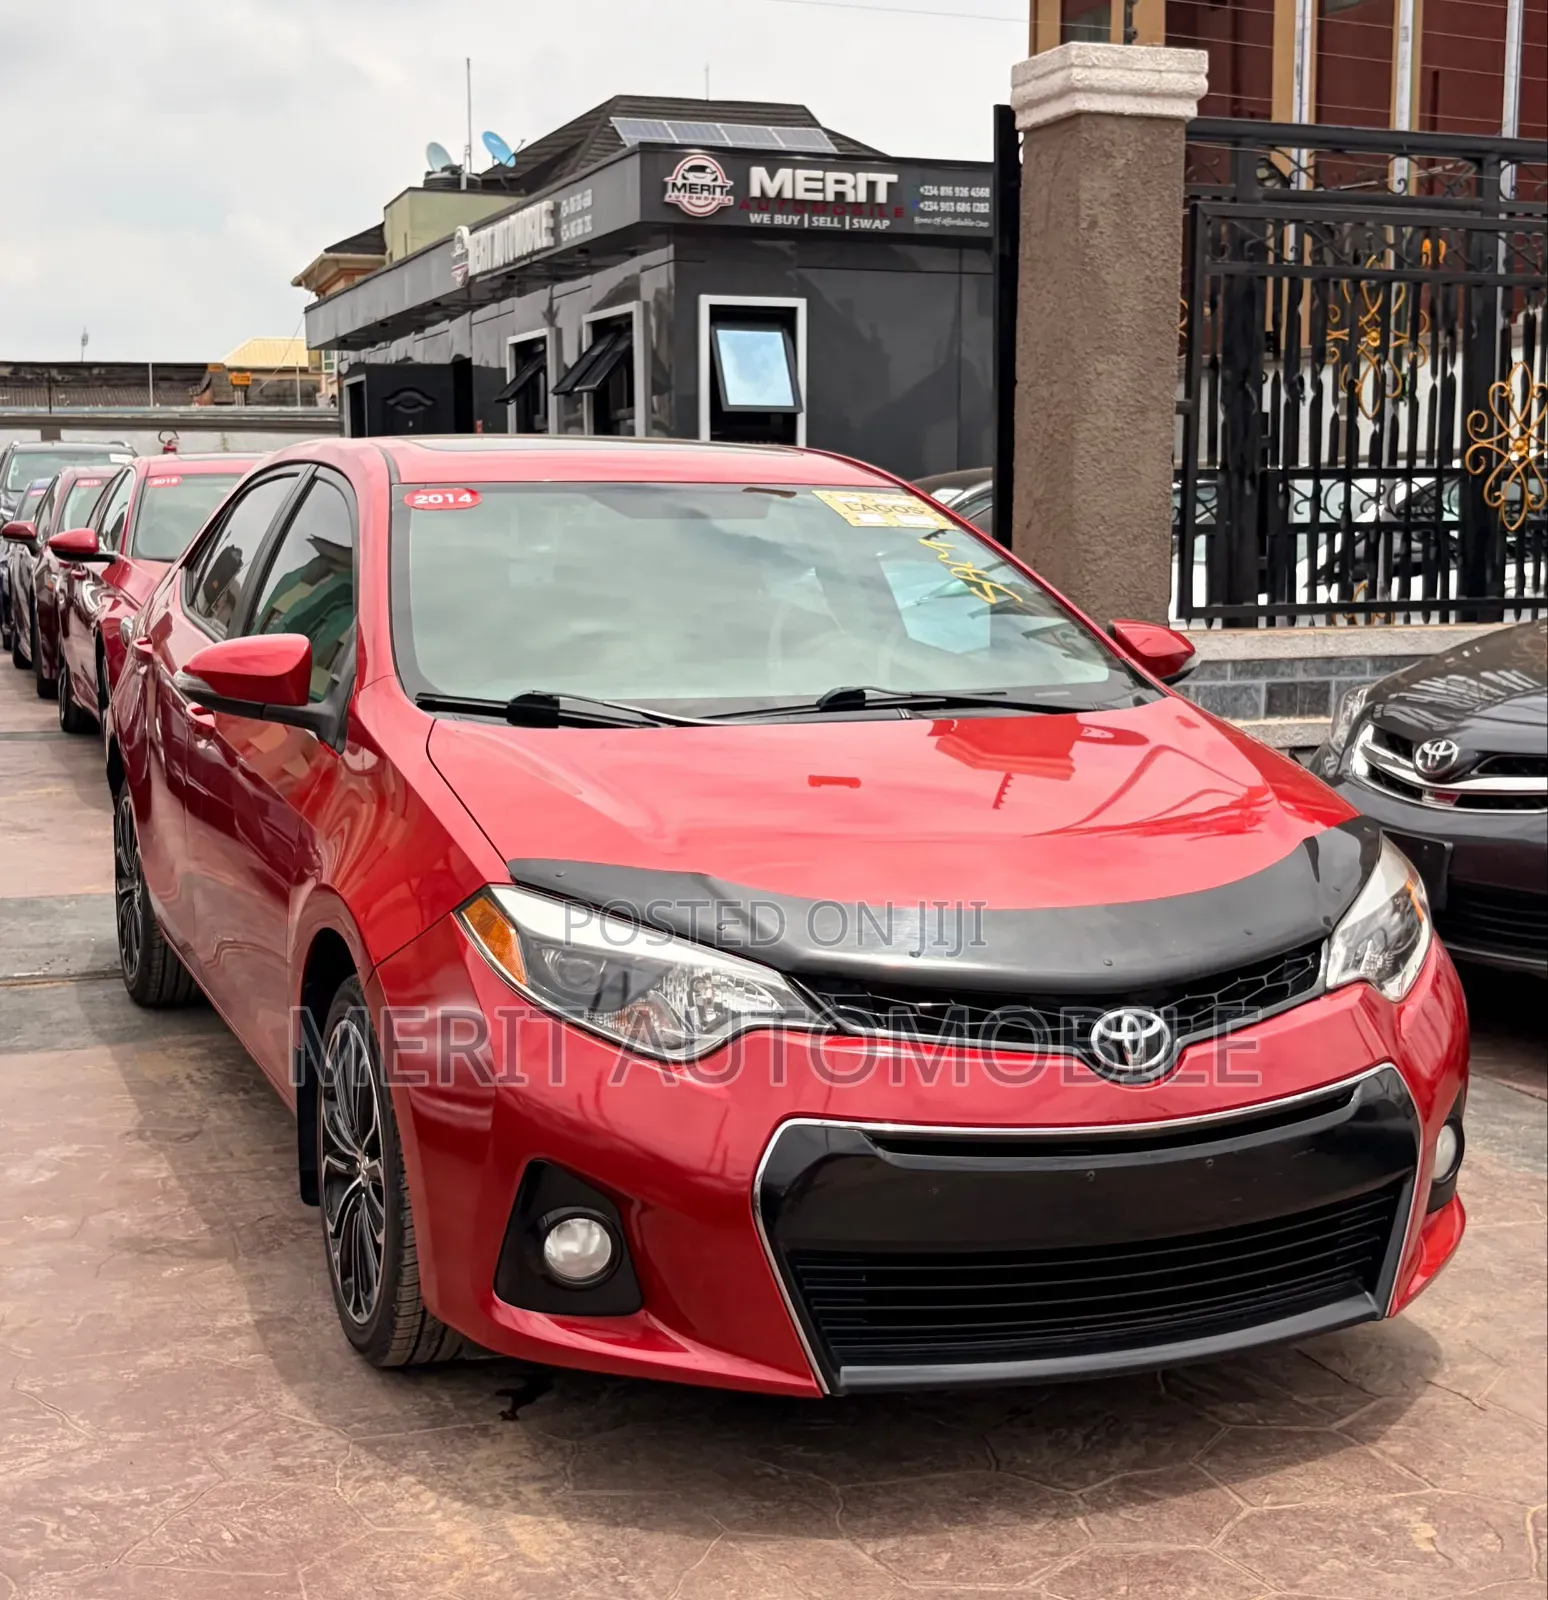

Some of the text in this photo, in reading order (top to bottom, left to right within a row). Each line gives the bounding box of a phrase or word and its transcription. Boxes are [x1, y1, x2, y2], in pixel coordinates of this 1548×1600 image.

[671, 182, 729, 197] MERIT
[749, 166, 899, 204] MERIT
[668, 194, 732, 203] AUTOMOBILE
[738, 200, 905, 218] AUTOMOBILE
[749, 213, 891, 230] WE BUY SELL SWAP
[413, 493, 473, 505] 2014
[843, 502, 925, 515] LAGOS
